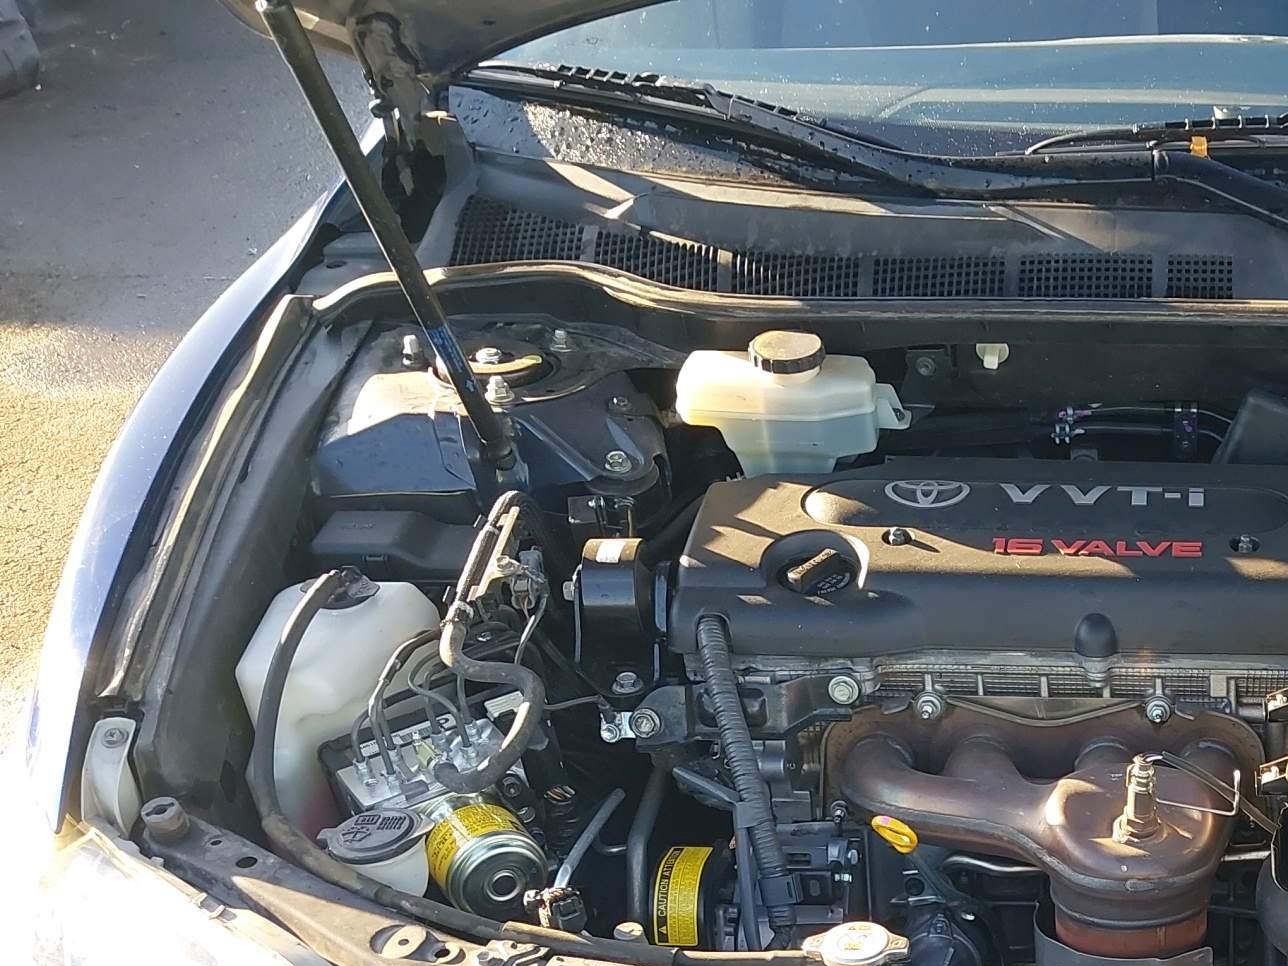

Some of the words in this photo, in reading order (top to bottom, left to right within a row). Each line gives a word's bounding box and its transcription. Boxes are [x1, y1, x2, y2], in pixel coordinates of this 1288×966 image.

[1000, 483, 1205, 507] VVT-i
[991, 537, 1045, 556] 16
[1050, 538, 1204, 558] VALVE
[658, 879, 669, 917] CAUTION
